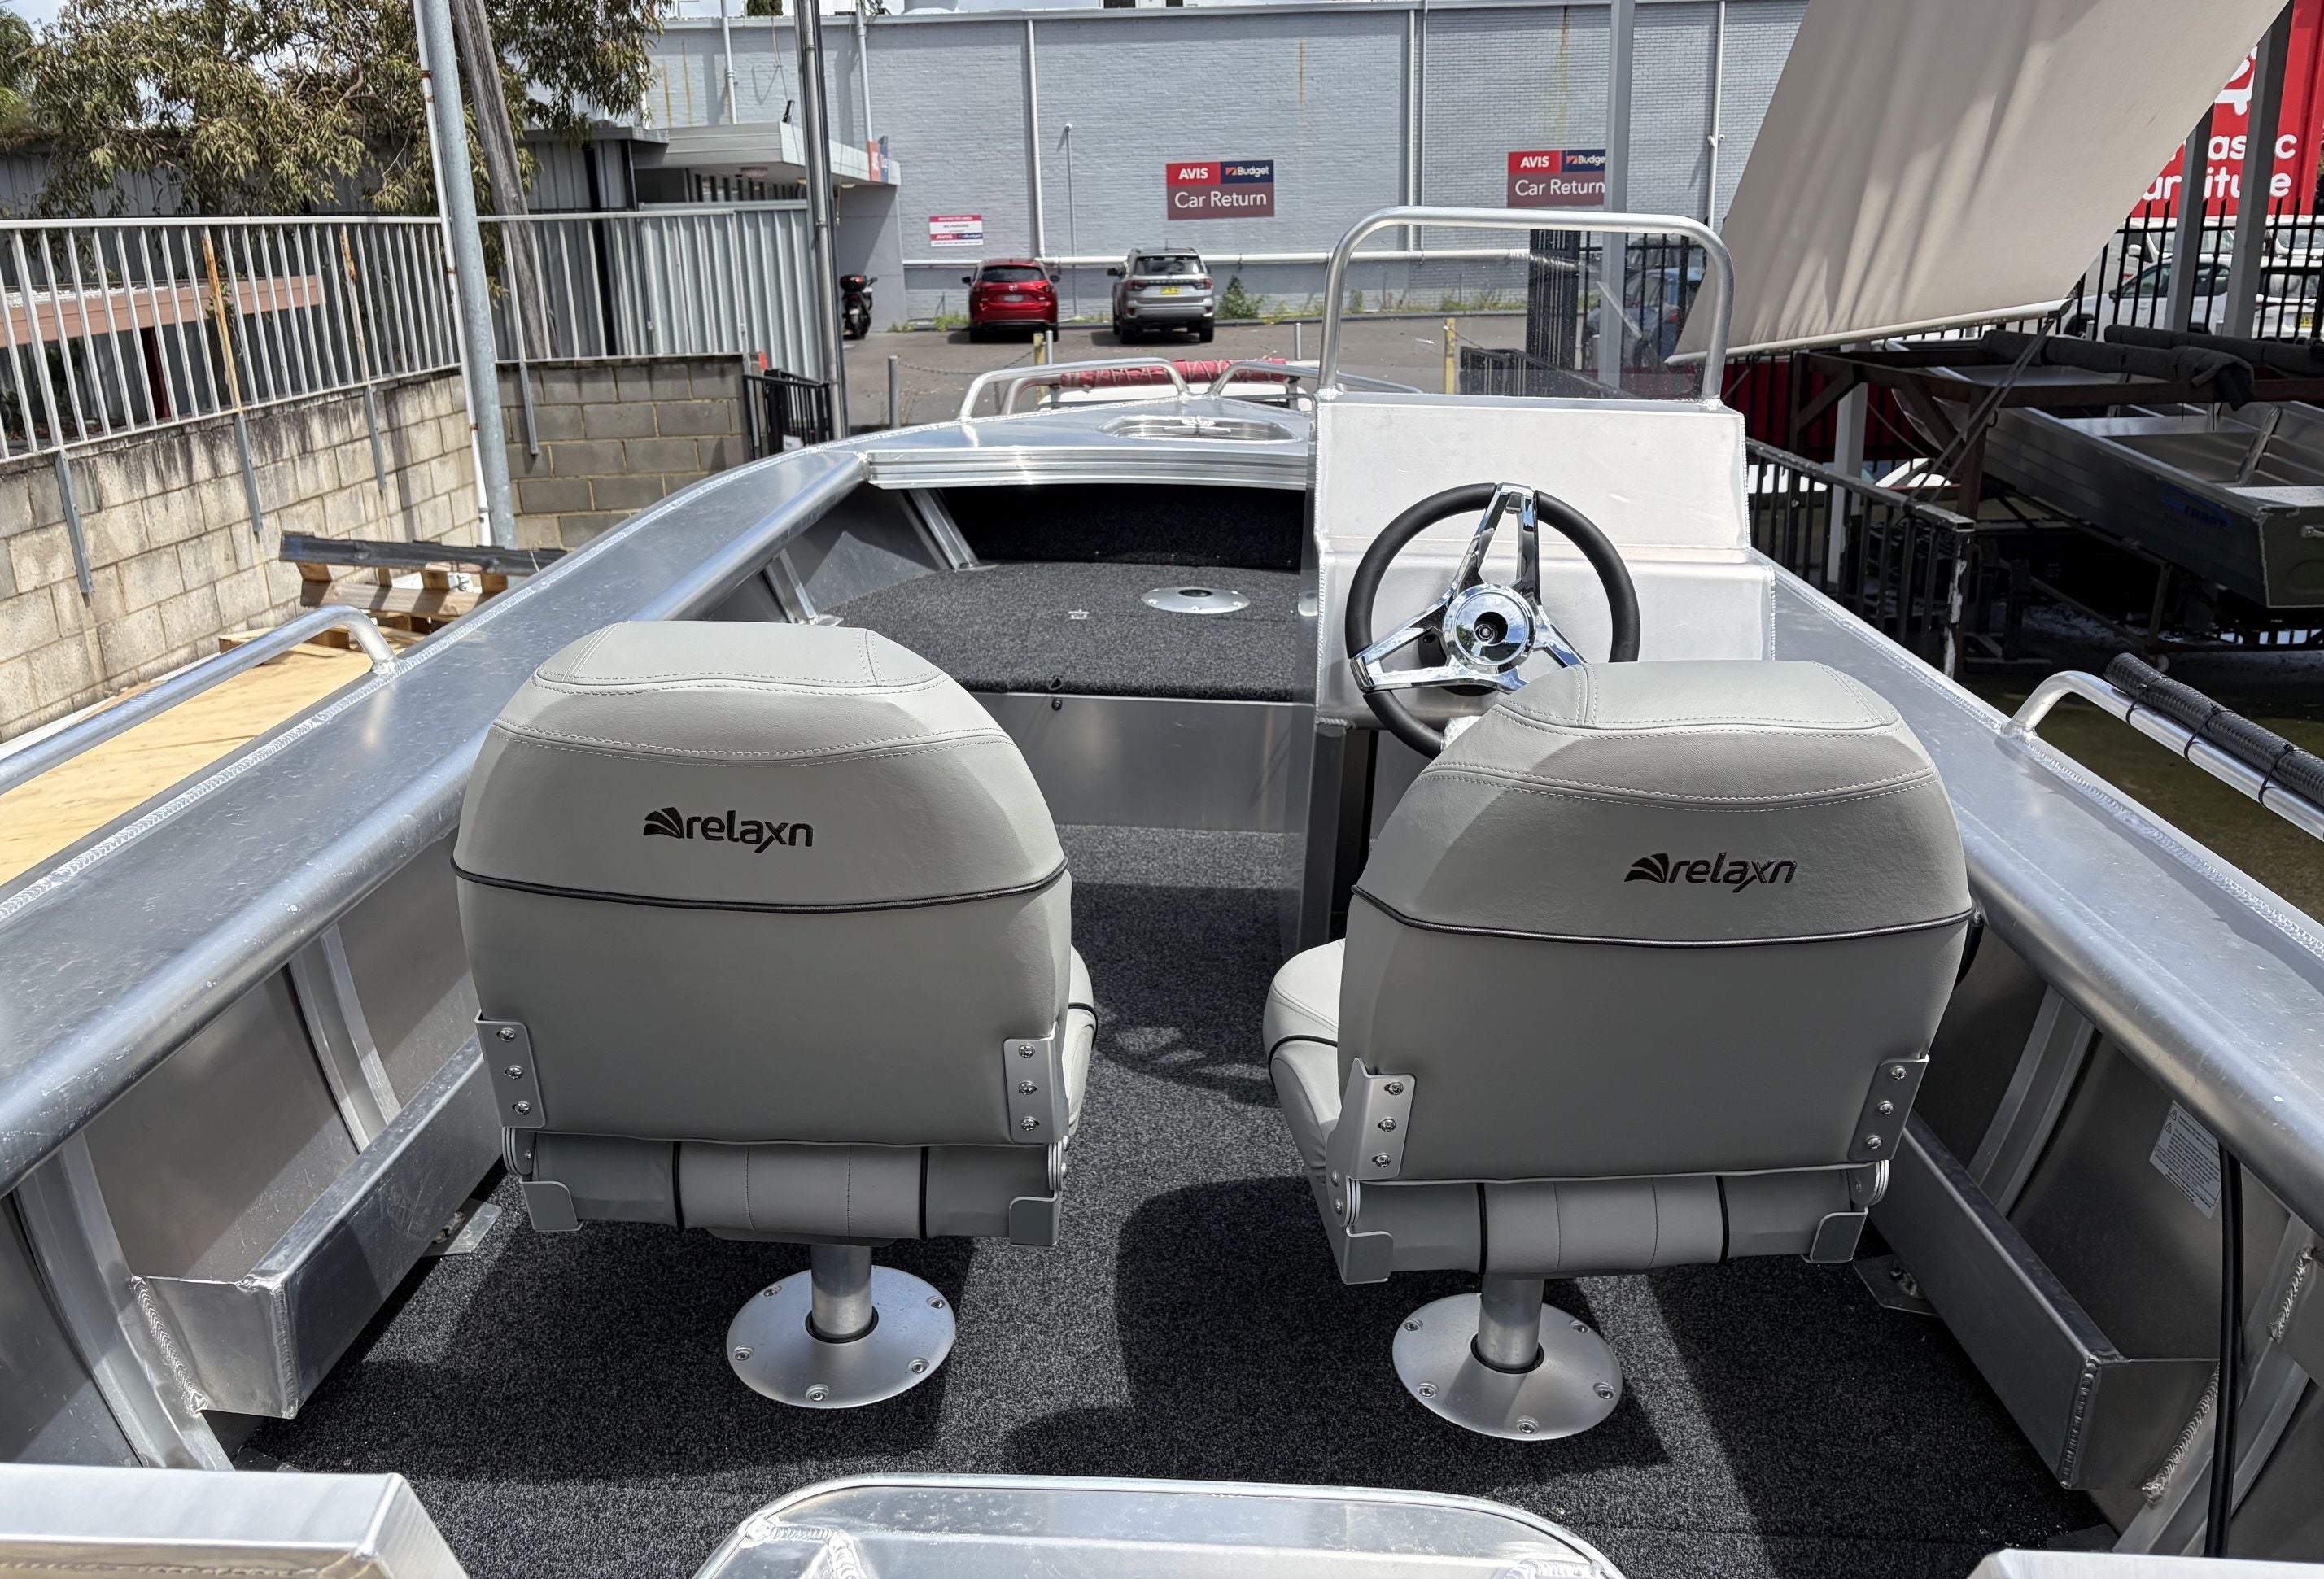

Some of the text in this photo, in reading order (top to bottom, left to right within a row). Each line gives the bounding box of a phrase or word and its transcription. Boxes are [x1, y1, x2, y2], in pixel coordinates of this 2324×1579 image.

[1520, 155, 1605, 168] AVIS Budge
[1178, 166, 1269, 179] AVIS Budget
[1515, 178, 1605, 196] Car Return
[1174, 191, 1267, 208] Car Return
[686, 809, 814, 854] relaxn
[1667, 852, 1798, 893] relaxn
